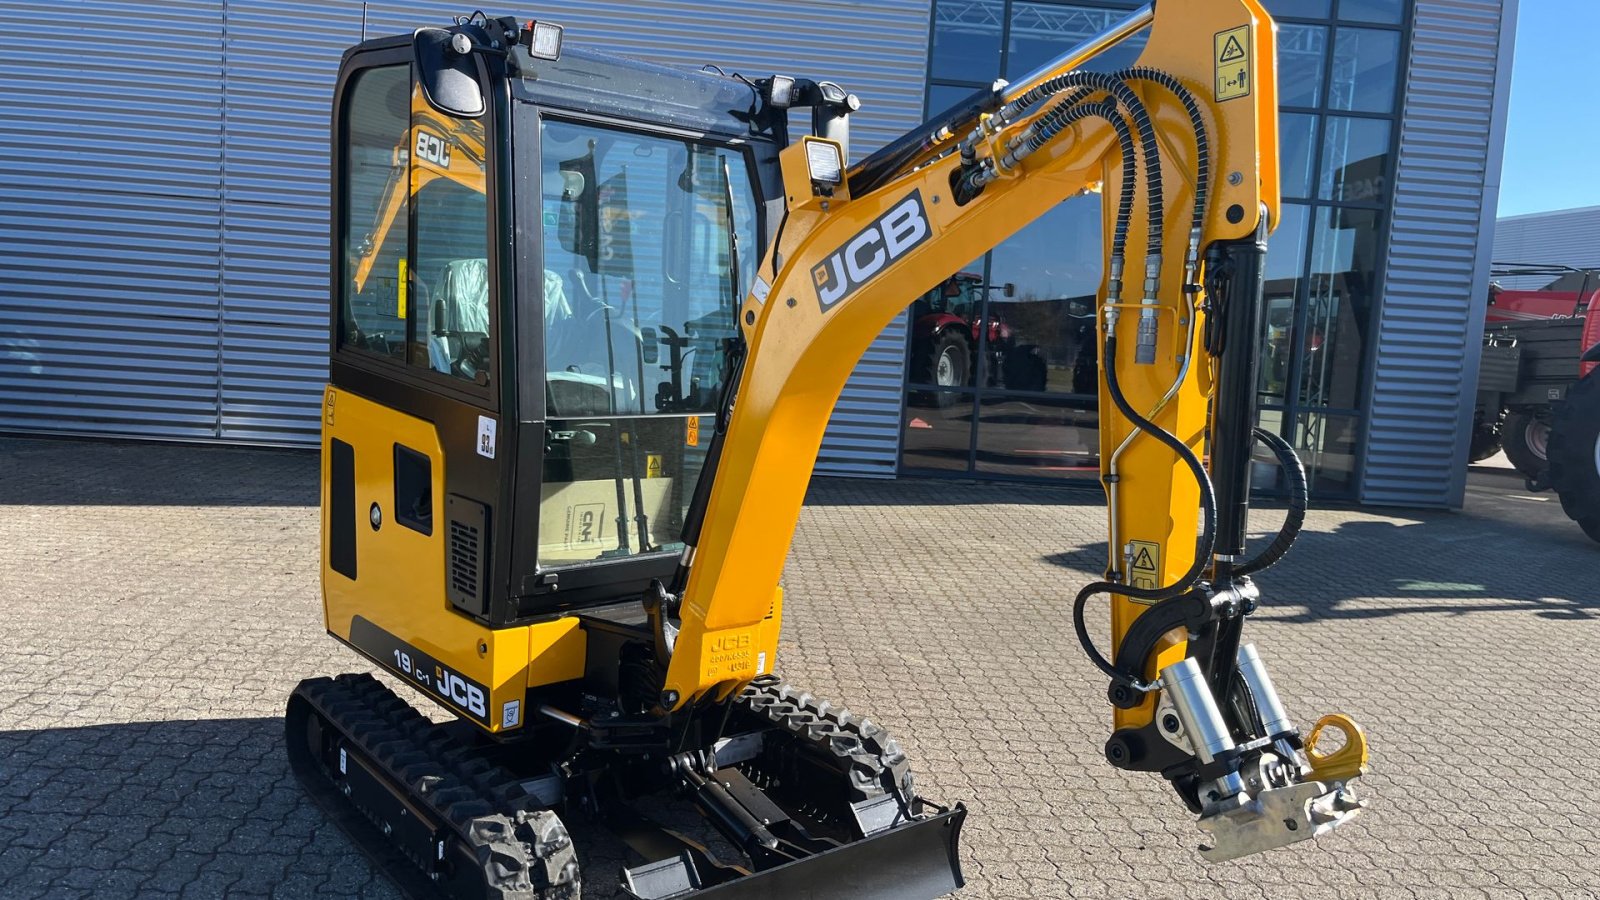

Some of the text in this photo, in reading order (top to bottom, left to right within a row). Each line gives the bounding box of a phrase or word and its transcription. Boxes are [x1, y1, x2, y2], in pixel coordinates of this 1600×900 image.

[820, 198, 927, 305] JCB
[481, 433, 489, 453] 93
[581, 511, 593, 542] CNH
[711, 635, 751, 652] JCB
[393, 649, 430, 685] 19 C-1
[436, 669, 486, 718] JCB
